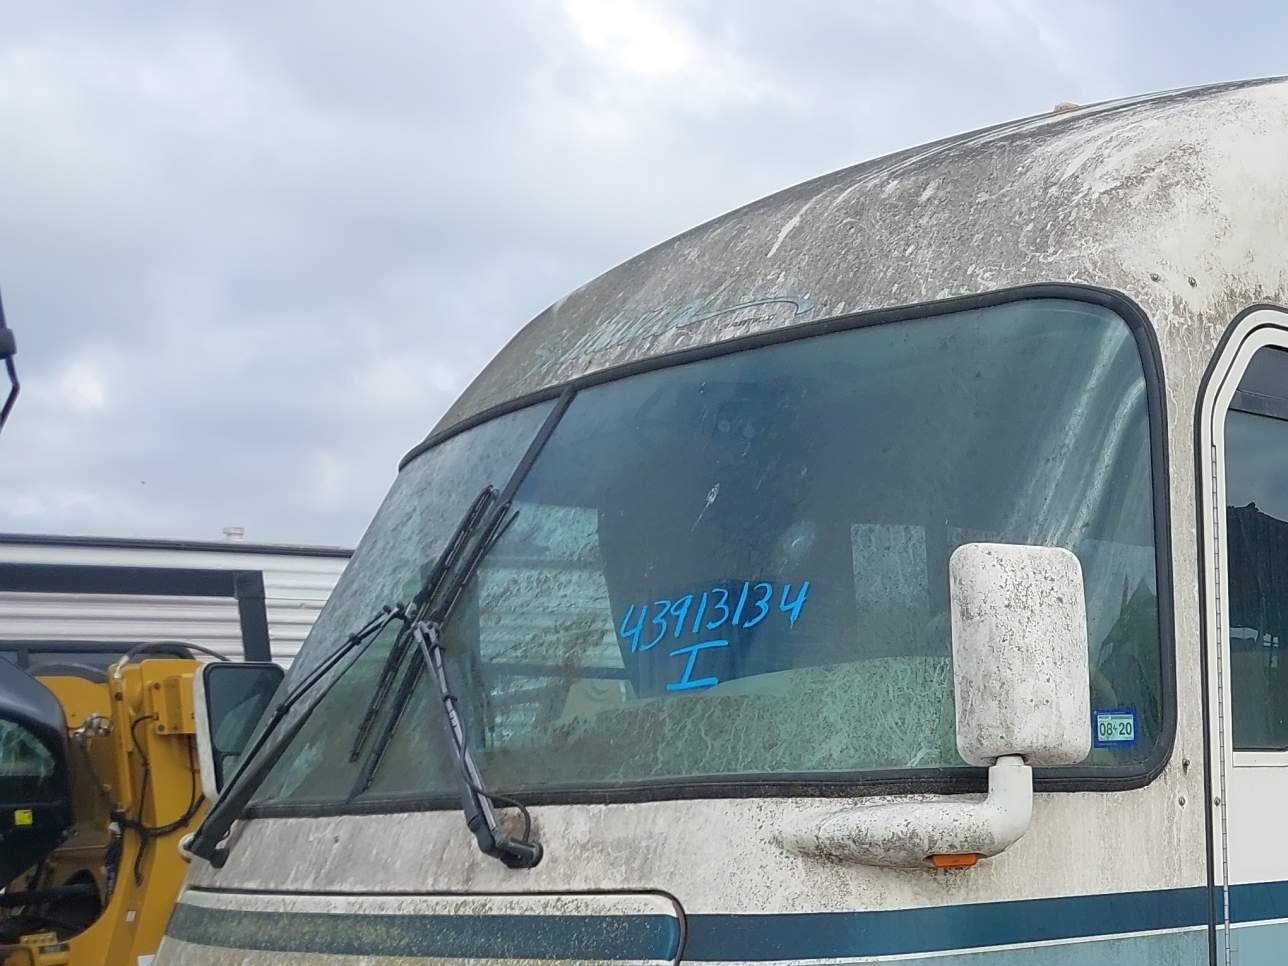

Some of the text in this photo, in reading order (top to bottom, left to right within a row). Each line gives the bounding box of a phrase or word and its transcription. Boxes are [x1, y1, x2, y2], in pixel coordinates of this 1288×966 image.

[620, 580, 810, 653] 43913134
[1099, 722, 1132, 736] 08 20
